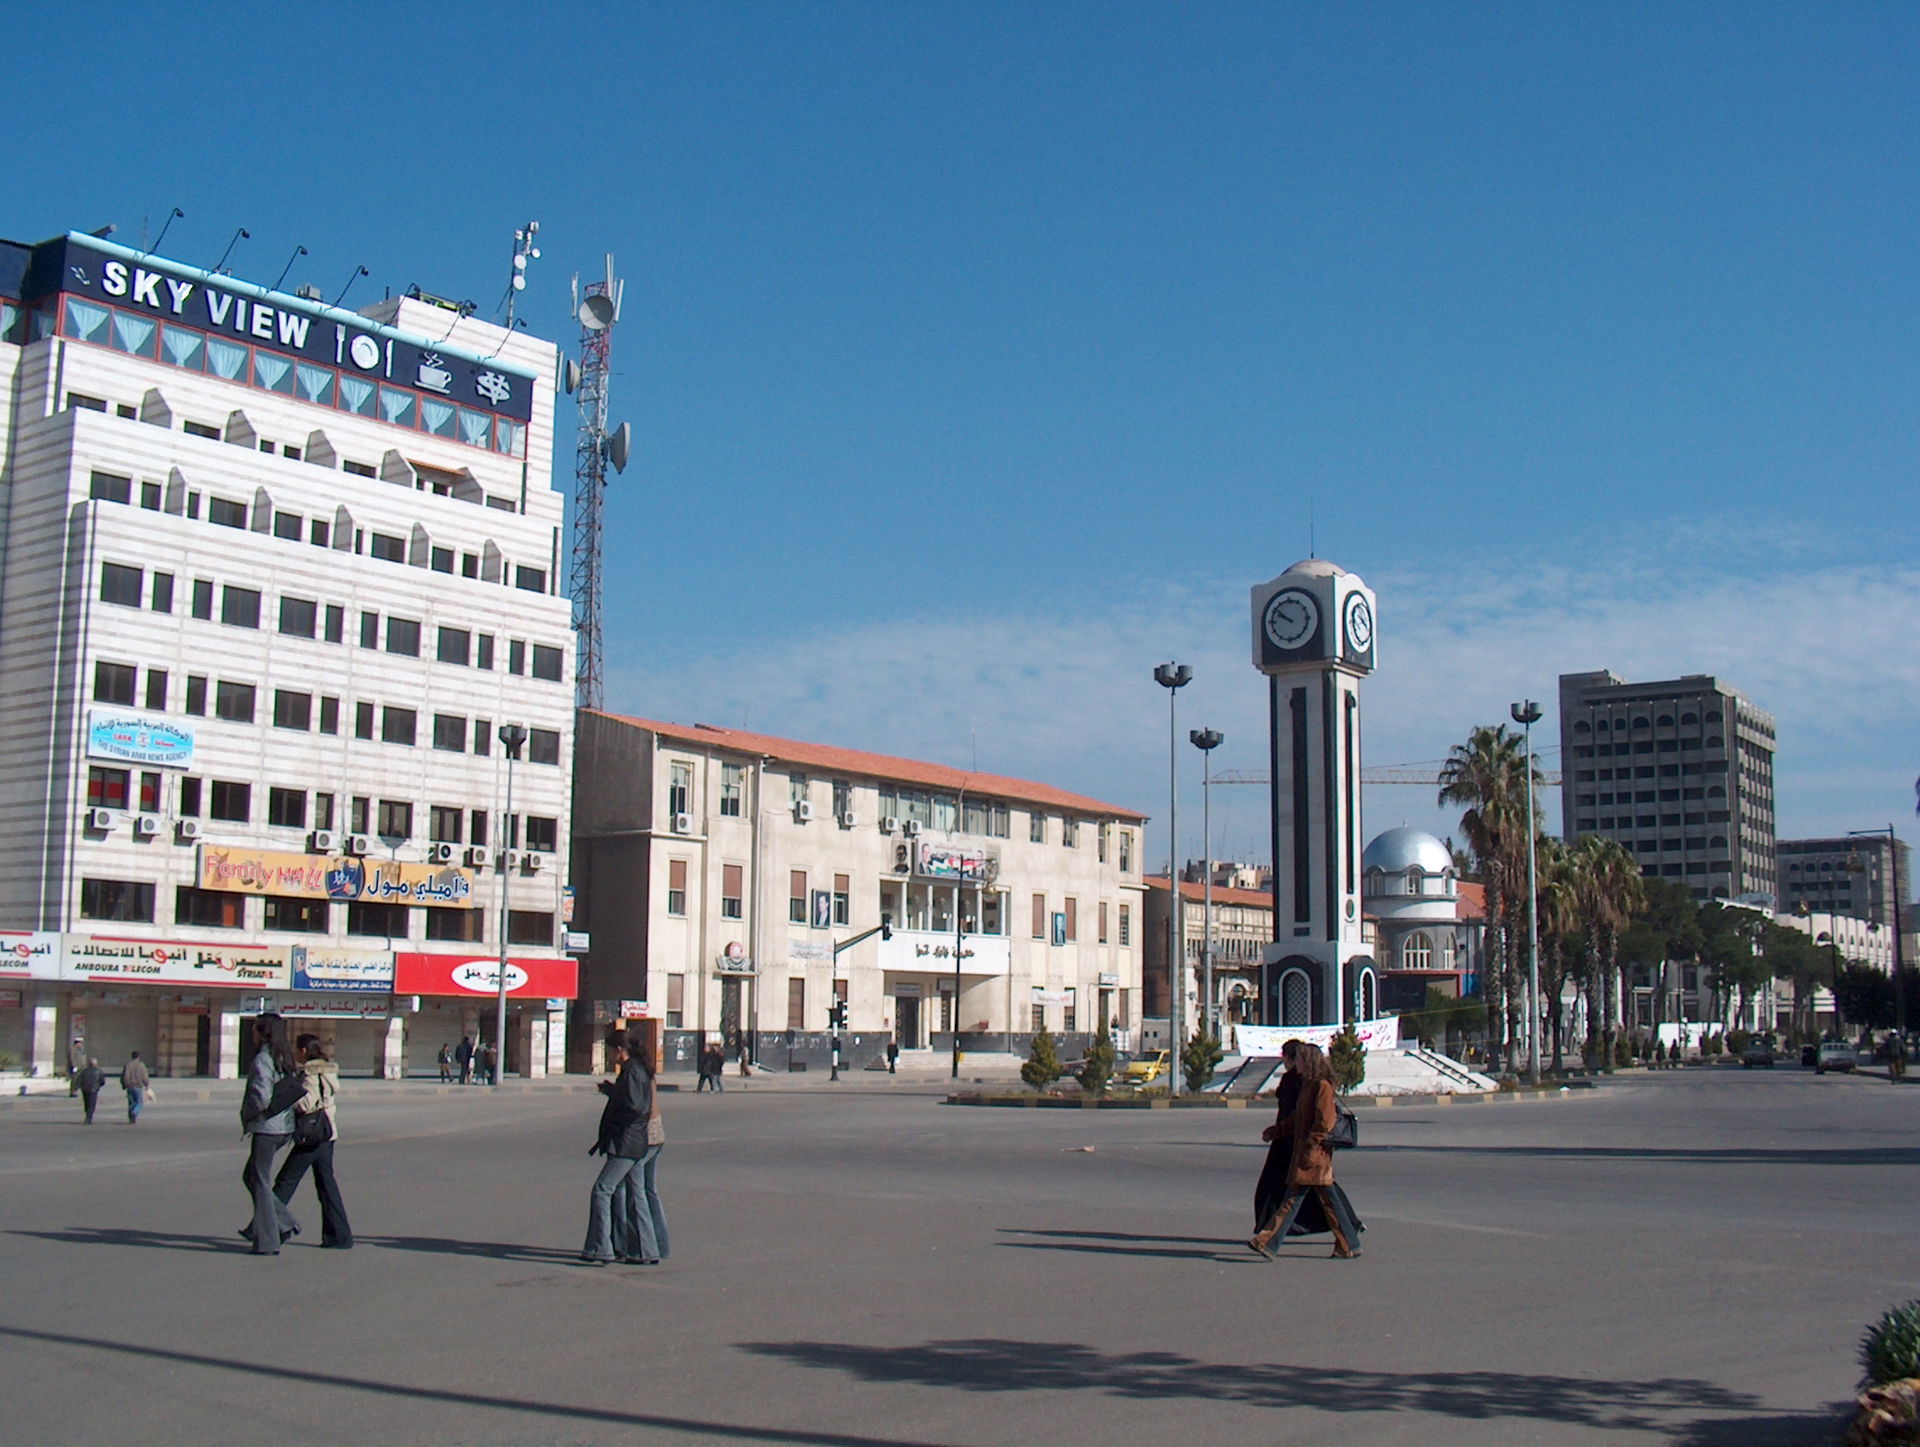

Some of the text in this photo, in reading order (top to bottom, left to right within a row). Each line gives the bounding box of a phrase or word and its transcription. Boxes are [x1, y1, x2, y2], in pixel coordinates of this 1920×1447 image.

[101, 260, 310, 349] SKY VIEW
[116, 718, 142, 729] السورية
[143, 718, 165, 732] العربية
[109, 744, 130, 757] SYRIAN
[131, 750, 148, 760] ARAB
[148, 752, 164, 761] NEWS
[165, 750, 188, 760] AGENCY
[205, 855, 274, 886] Family
[367, 869, 409, 895] مول
[72, 945, 134, 957] للاتصالات
[122, 964, 161, 974] TELECOM
[281, 1001, 319, 1013] العربي
[321, 1001, 358, 1014] الكتاب
